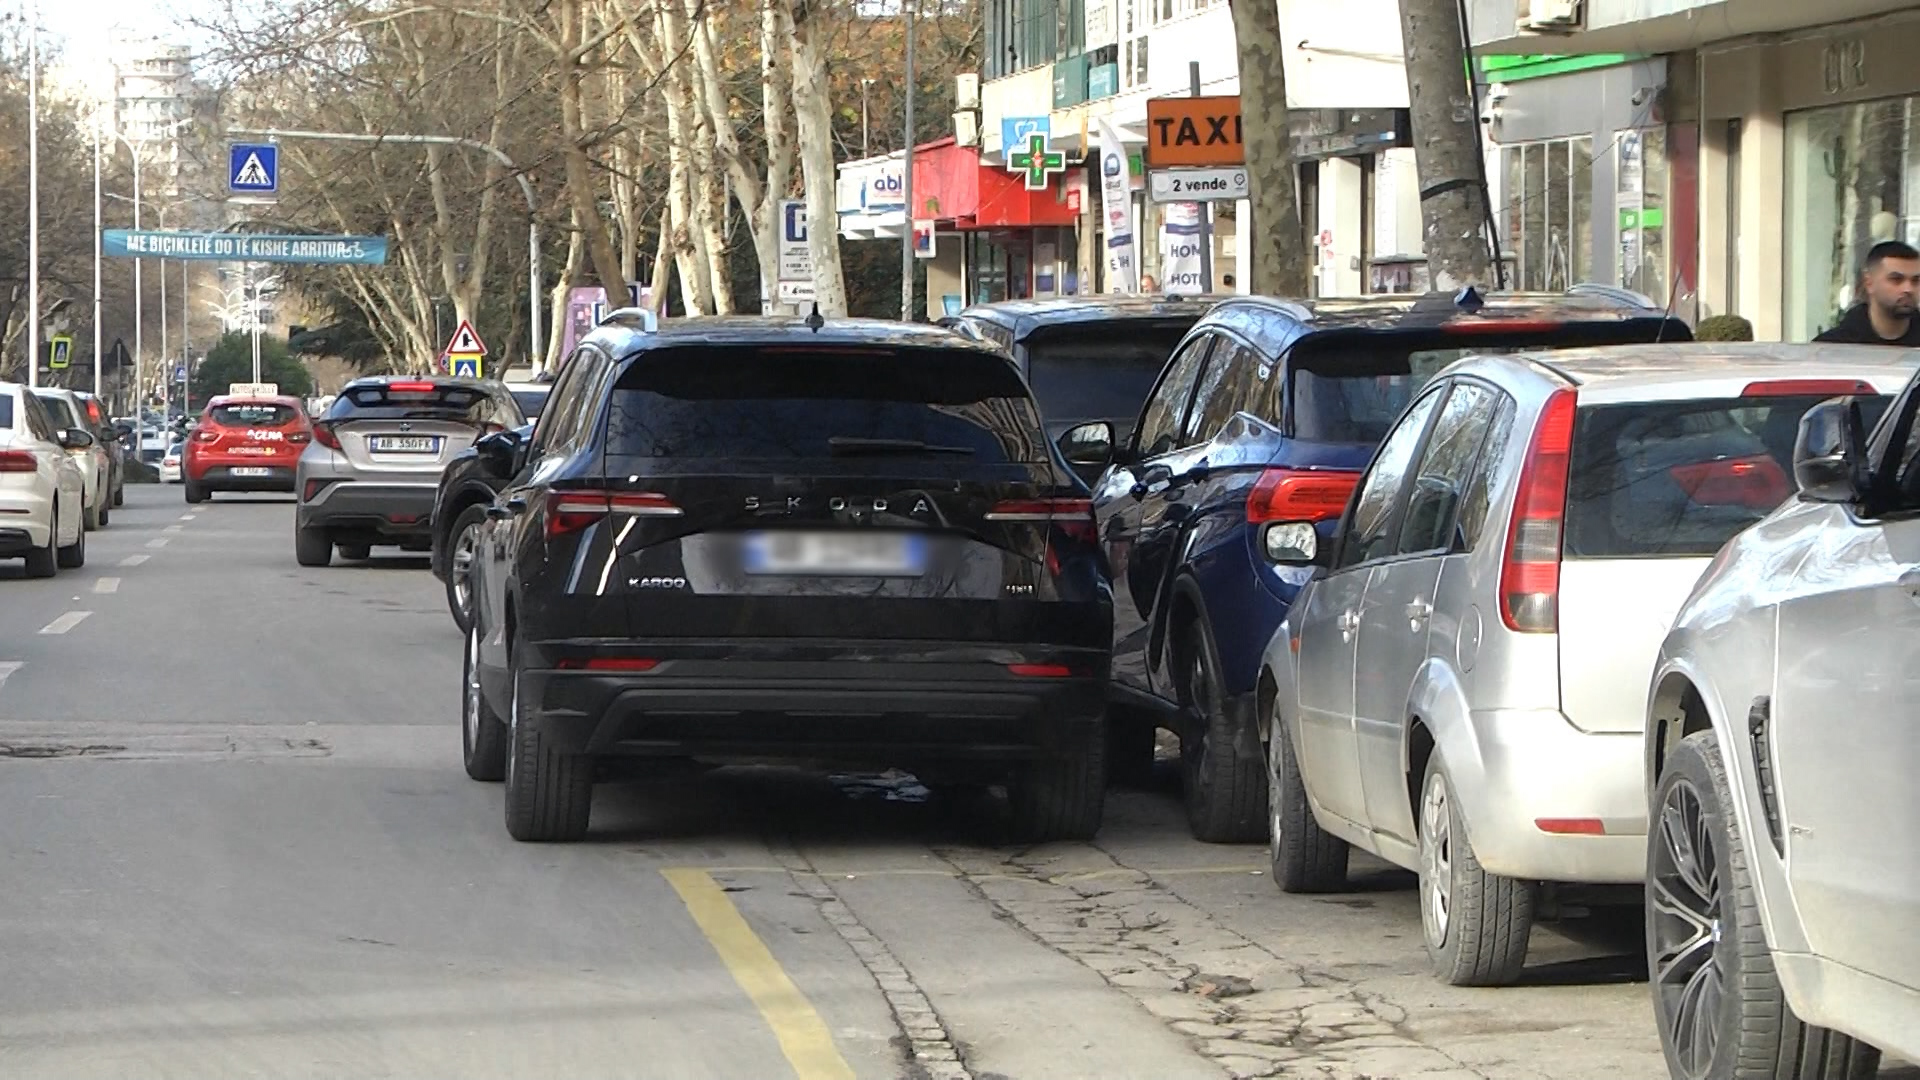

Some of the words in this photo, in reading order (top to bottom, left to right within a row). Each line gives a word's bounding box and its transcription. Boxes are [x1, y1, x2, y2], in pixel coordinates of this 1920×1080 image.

[1153, 115, 1243, 146] TAXI
[1173, 178, 1182, 192] 2
[1185, 177, 1227, 192] vende
[126, 235, 147, 252] ME
[214, 238, 233, 255] DO
[251, 239, 289, 256] KISHE
[1171, 272, 1202, 286] HOT
